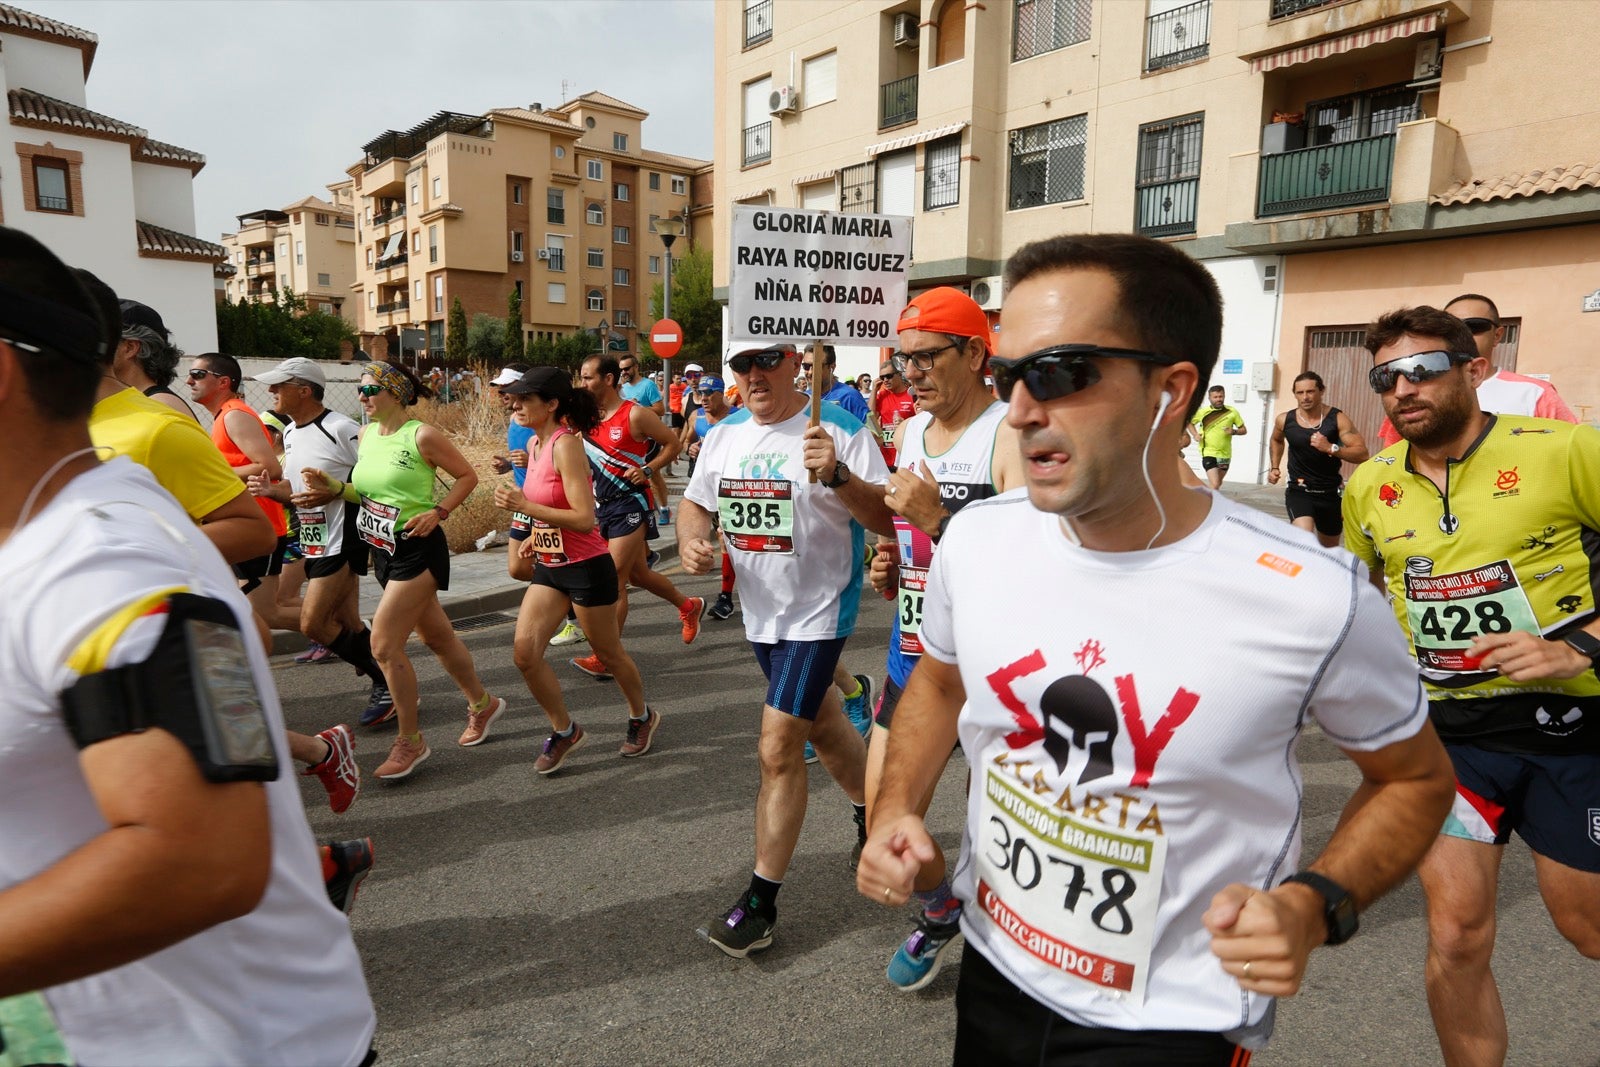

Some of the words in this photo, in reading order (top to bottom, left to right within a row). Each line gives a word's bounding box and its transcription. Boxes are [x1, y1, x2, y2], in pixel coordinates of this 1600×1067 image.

[753, 212, 826, 235] GLORIA
[832, 217, 893, 238] MARIA
[738, 247, 788, 267] RAYA
[794, 250, 904, 272] RODRIGUEZ
[755, 278, 802, 302] NIÑA
[809, 284, 885, 305] ROBADA
[748, 316, 840, 336] GRANADA
[847, 319, 890, 338] 1990
[951, 463, 972, 472] YESTE
[731, 482, 744, 490] GRAN
[745, 481, 763, 490] PREMIO
[764, 482, 770, 490] DE
[771, 482, 788, 490] FONDO
[360, 511, 390, 537] 3074
[729, 501, 781, 530] 385
[1413, 578, 1432, 590] GRAN
[1430, 576, 1462, 590] PREMIO
[1462, 573, 1474, 586] DE
[1474, 565, 1504, 584] FONDO
[1447, 586, 1487, 598] CRUZCAMPO
[1420, 600, 1512, 641] 428
[1062, 825, 1146, 865] GRANADA
[986, 815, 1136, 935] 3078
[984, 889, 1094, 976] Cruzcampo
